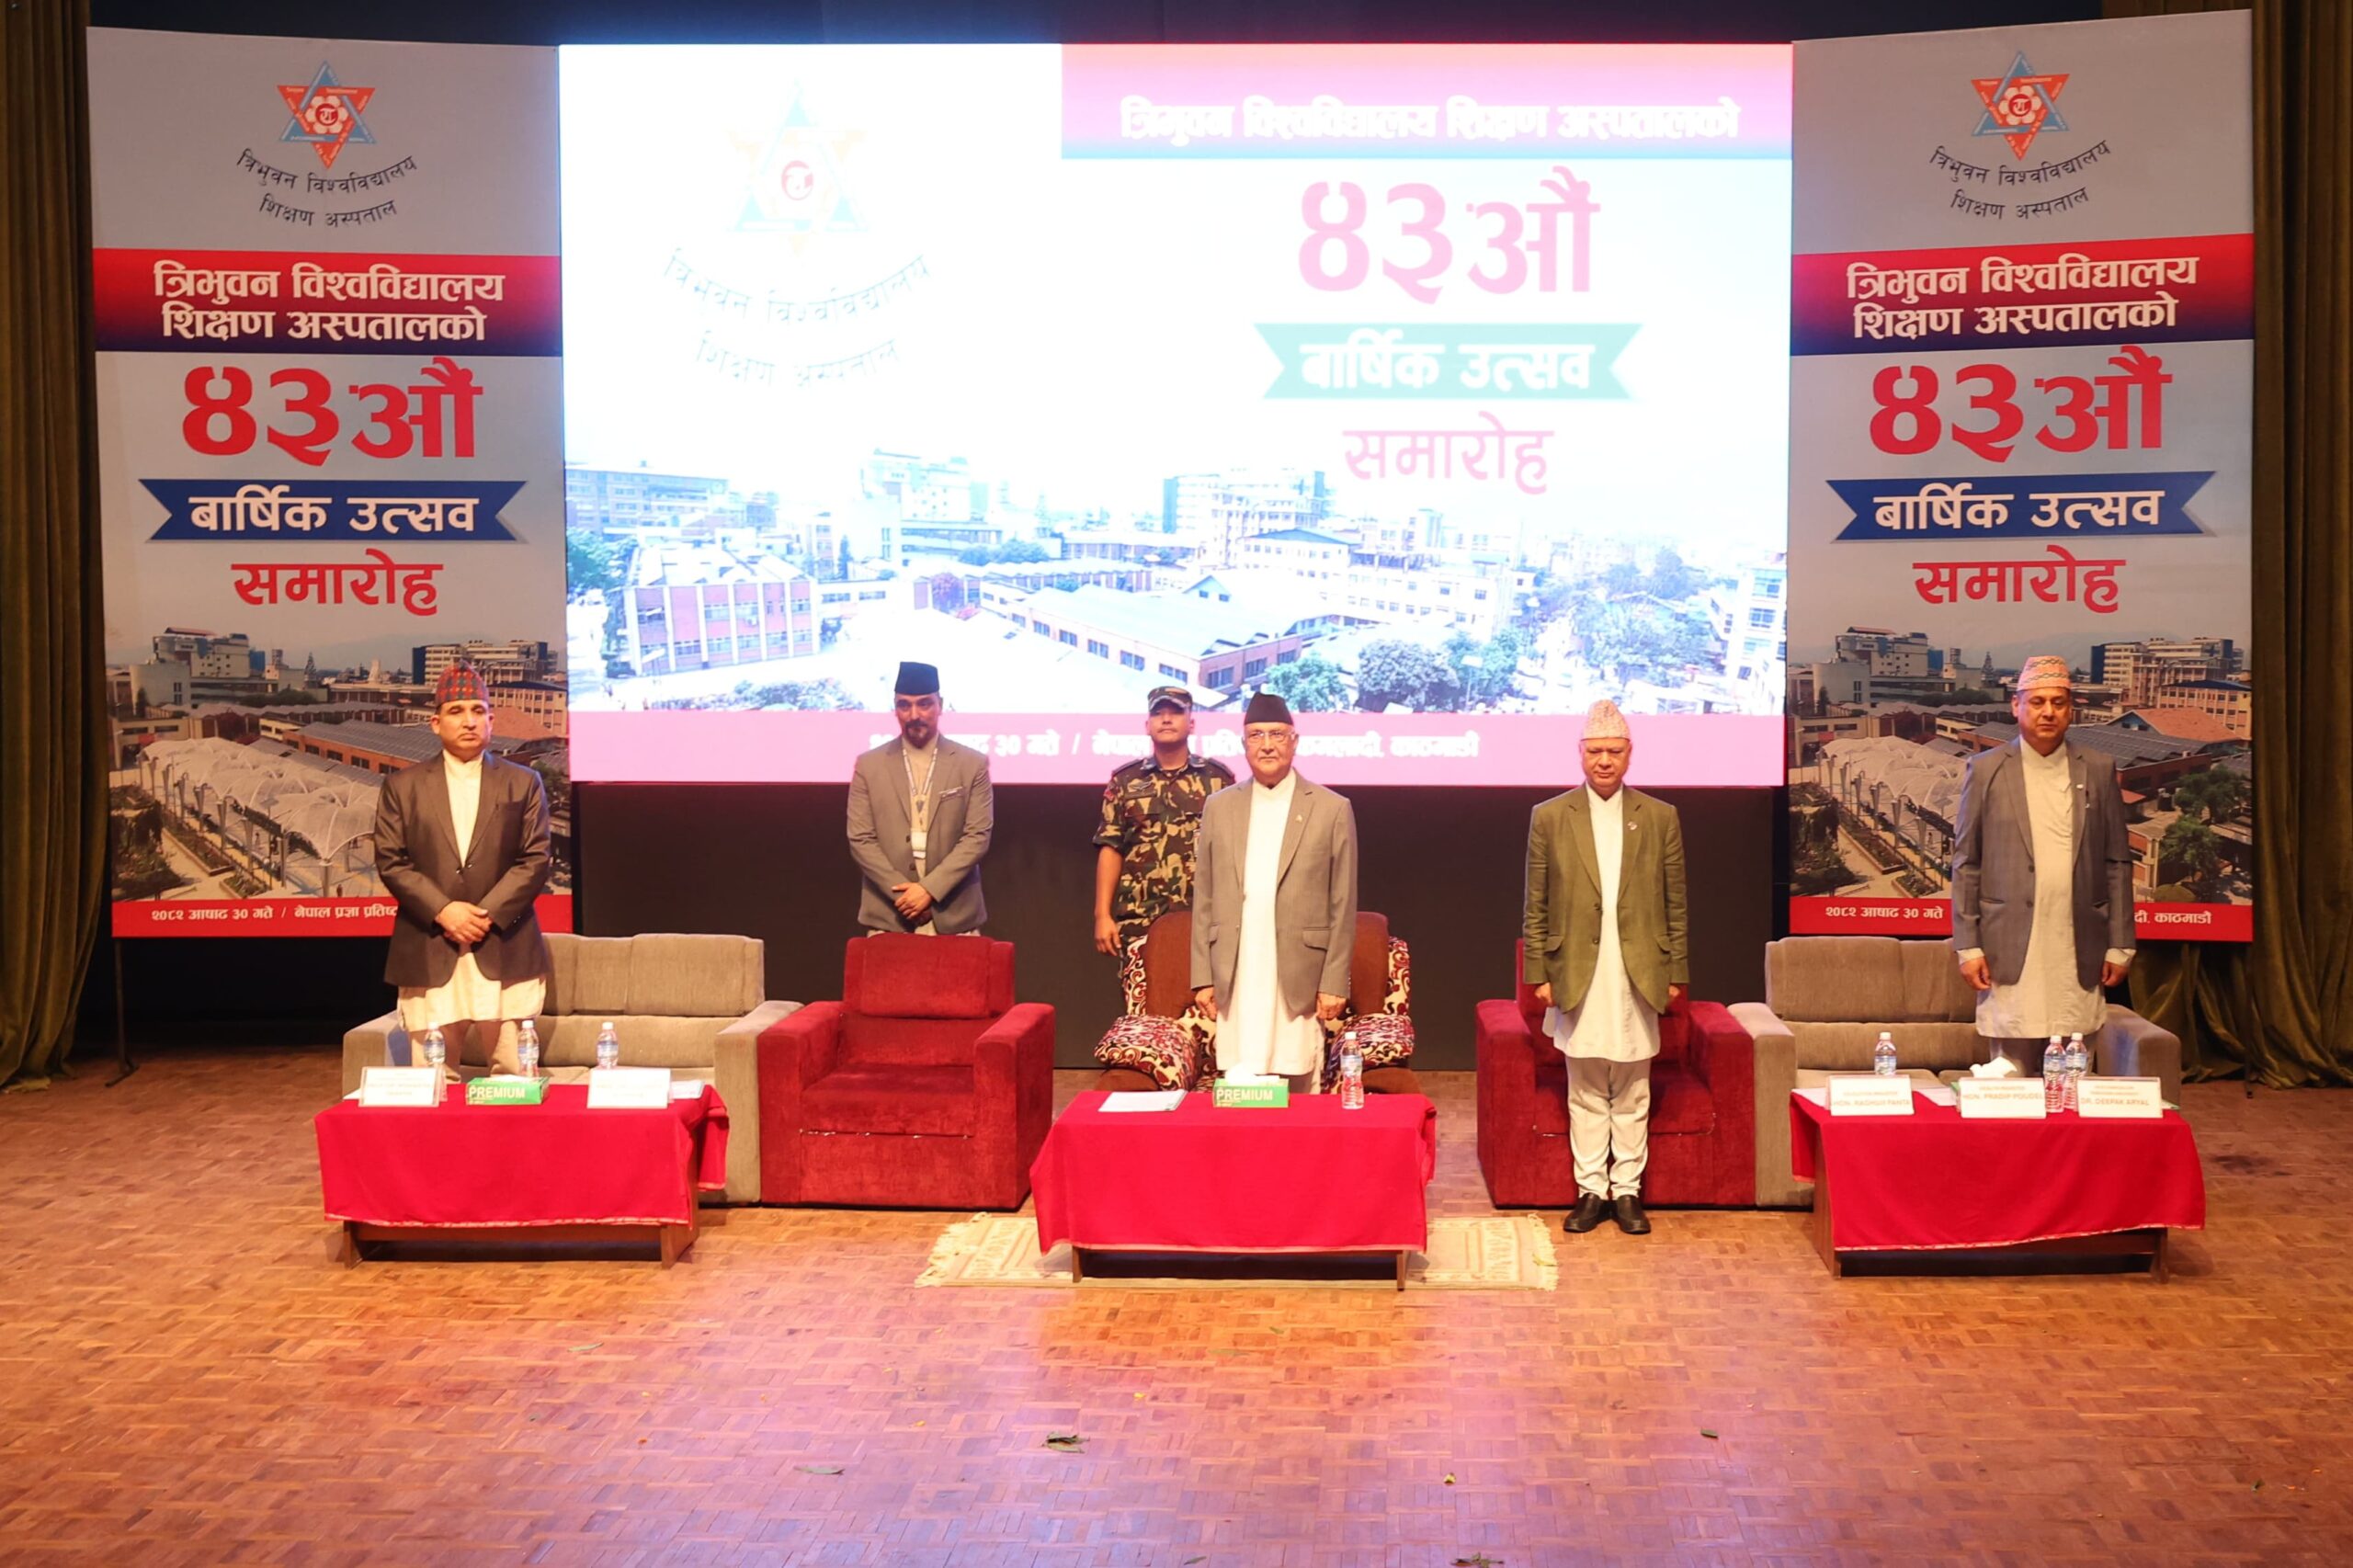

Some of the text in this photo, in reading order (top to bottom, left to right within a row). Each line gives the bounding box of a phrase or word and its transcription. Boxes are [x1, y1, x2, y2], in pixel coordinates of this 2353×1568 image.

[236, 148, 417, 193] त्रिभुवन विश्वविद्यालय
[1930, 139, 2111, 186] त्रिभुवन विश्वविद्यालय
[258, 195, 397, 228] शिक्षण अस्पताल
[1949, 187, 2089, 220] शिक्षण अस्पताल
[153, 259, 506, 305] त्रिभुवन विश्वविद्यालय
[1847, 253, 2200, 304] त्रिभुवन विश्वविद्यालय
[162, 301, 487, 342] शिक्षण अस्पतालको
[1853, 290, 2179, 340] शिक्षण अस्पतालको
[1458, 344, 1597, 392] उत्सव
[1342, 410, 1555, 495] समारोह
[347, 497, 480, 534] उत्सव
[2029, 490, 2165, 529] उत्सव
[231, 548, 444, 617] समारोह
[1912, 544, 2127, 614] समारोह
[152, 909, 184, 921] २०८२
[232, 908, 249, 920] ३०
[280, 906, 287, 918] /
[294, 904, 331, 918] नेपाल
[1824, 905, 1858, 917] २०८२
[1903, 906, 1919, 919] ३०
[468, 1085, 526, 1099] PREMIUM
[1216, 1087, 1274, 1101] PREMIUM
